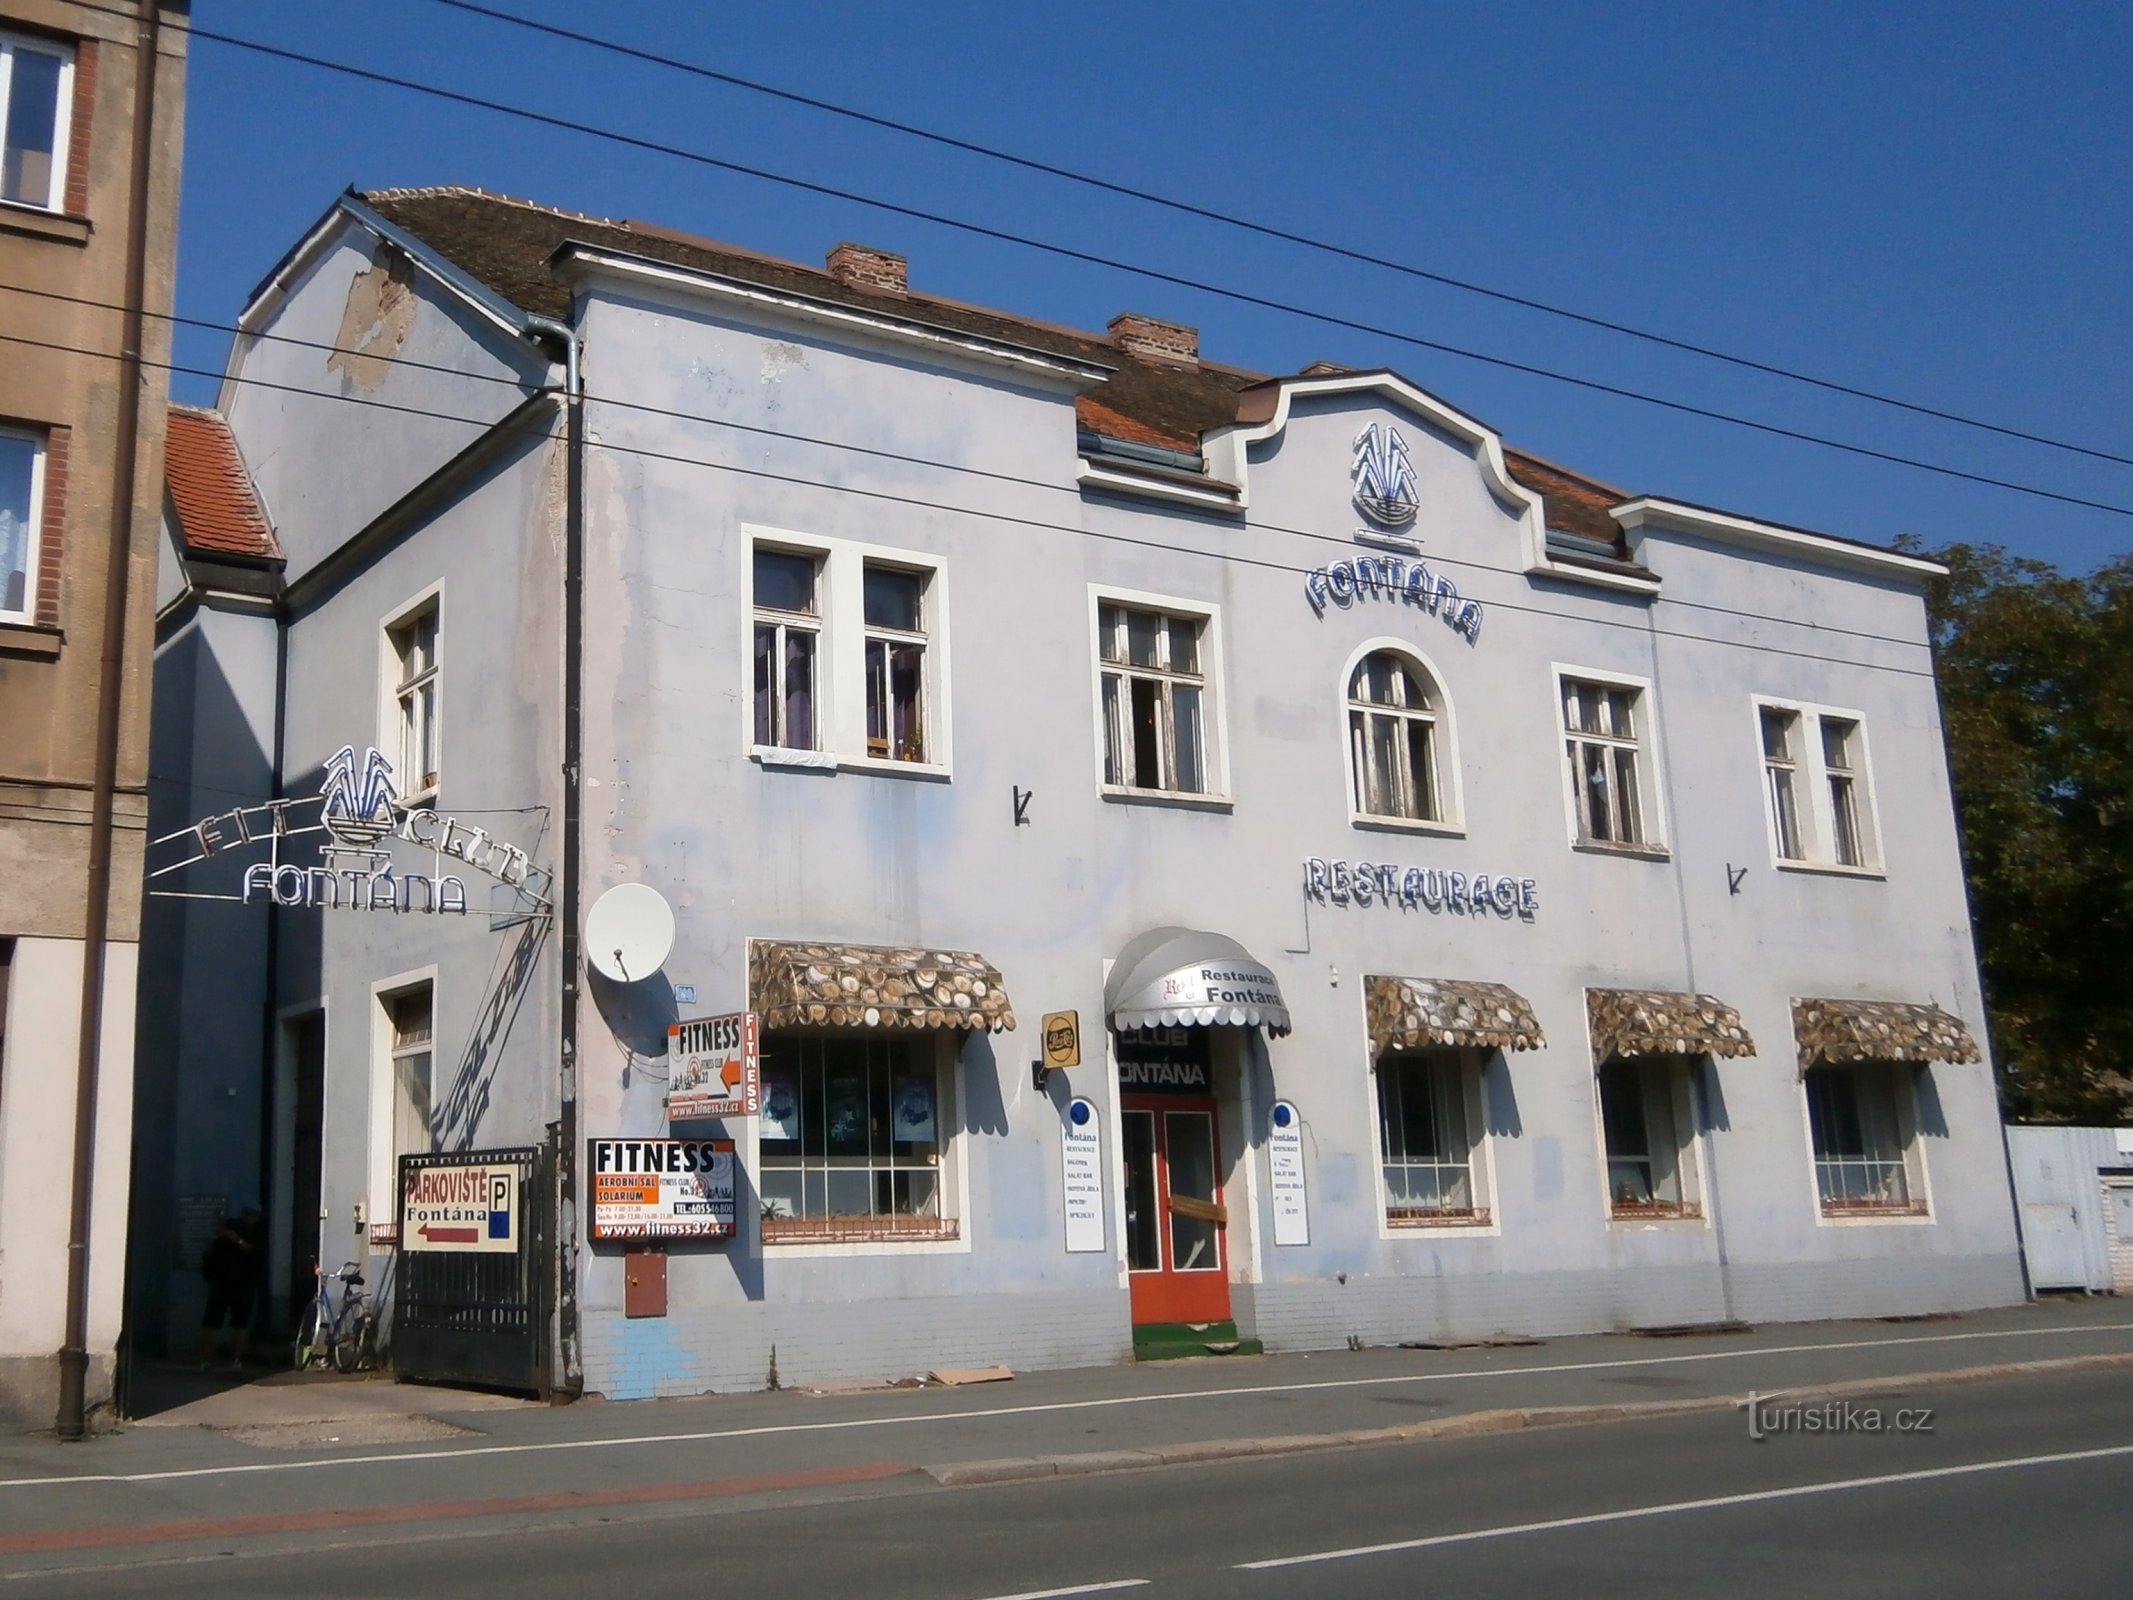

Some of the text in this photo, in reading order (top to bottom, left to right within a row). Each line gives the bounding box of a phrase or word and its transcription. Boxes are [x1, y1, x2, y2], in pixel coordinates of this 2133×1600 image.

[197, 798, 529, 891] FIT CLUB
[243, 862, 467, 916] FONTÁNA
[1303, 856, 1539, 915] RESTAURACE
[1206, 987, 1282, 1006] Fontána
[679, 1017, 740, 1055] FITNESS
[746, 1014, 758, 1111] FITNESS
[1118, 1056, 1206, 1085] ONTÁNA
[597, 1143, 715, 1173] FITNESS
[407, 1167, 488, 1204] PARKOVIŠTĚ
[494, 1181, 506, 1211] P
[598, 1191, 643, 1201] SOLARIUM
[407, 1206, 488, 1222] Fontána
[600, 1220, 728, 1238] www.fitness32.cz
